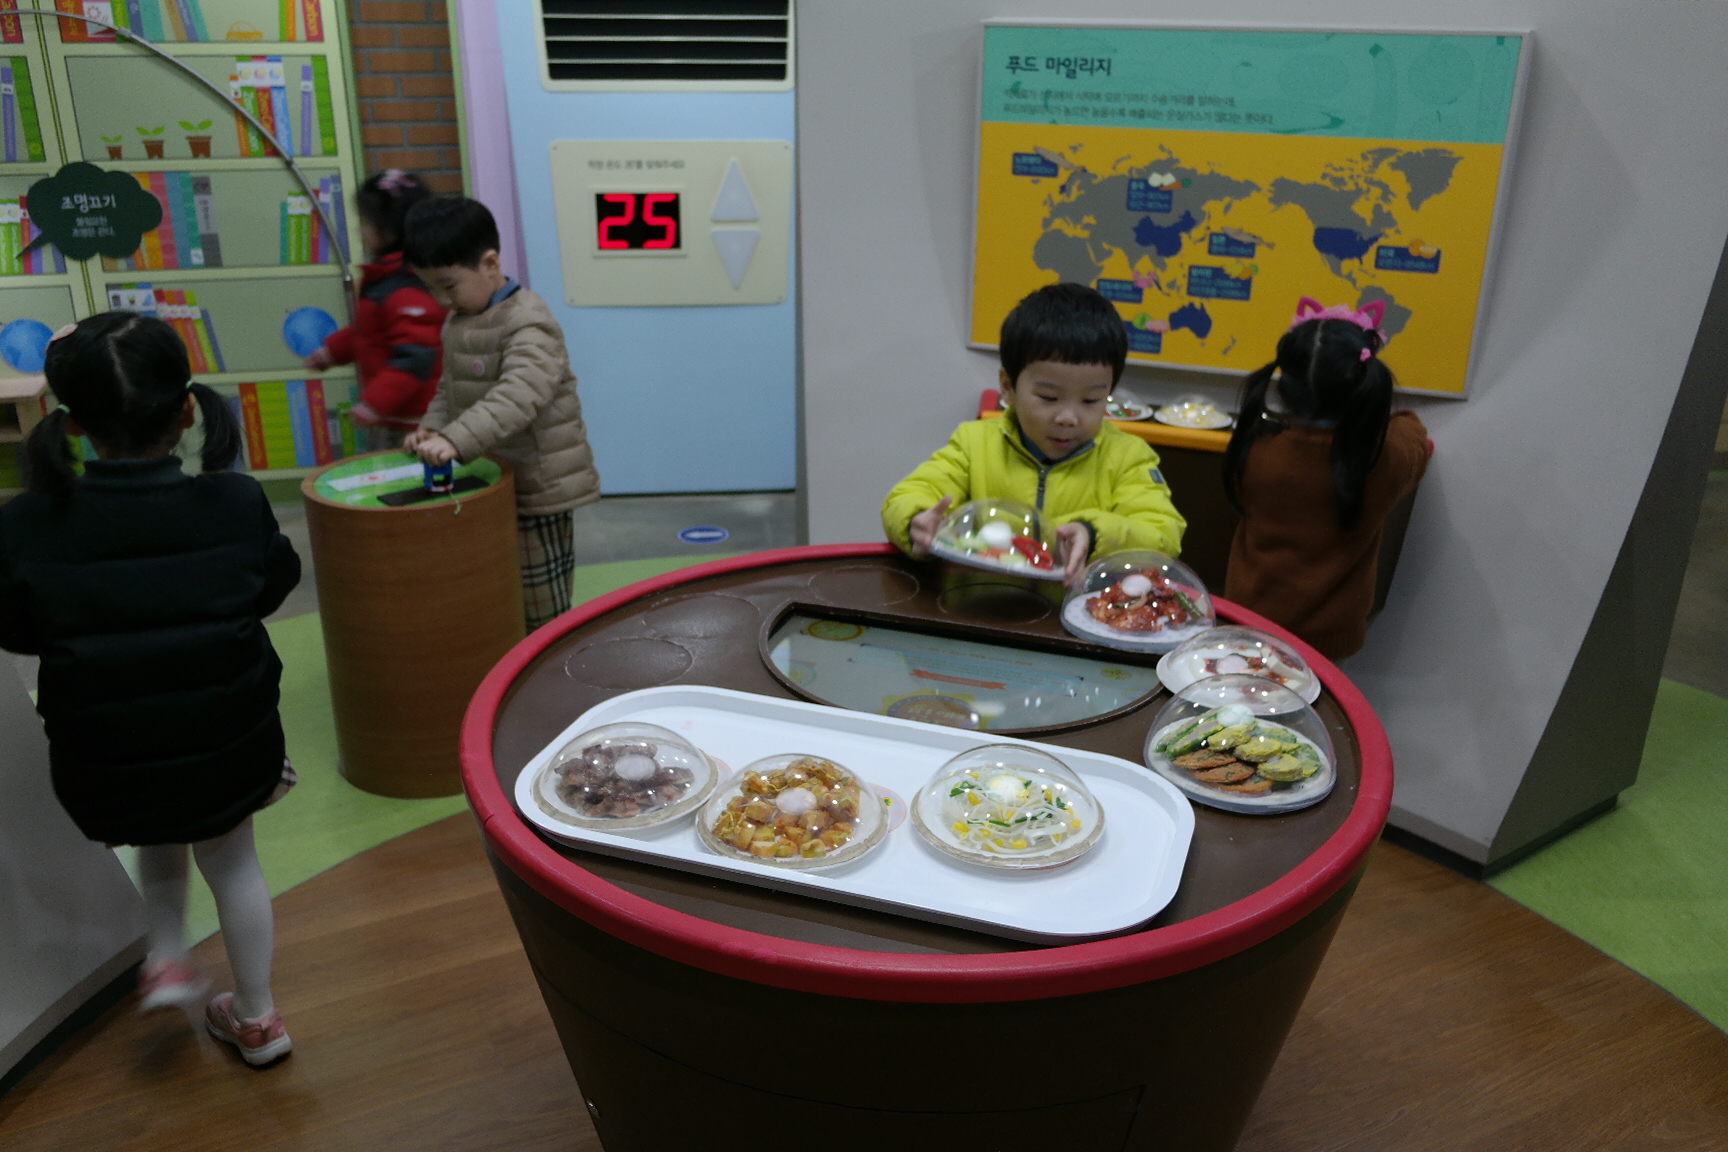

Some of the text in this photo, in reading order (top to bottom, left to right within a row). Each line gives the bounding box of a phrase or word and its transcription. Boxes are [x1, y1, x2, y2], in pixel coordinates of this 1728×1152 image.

[1005, 55, 1112, 79] 푸드 마일리지
[598, 193, 677, 249] 25
